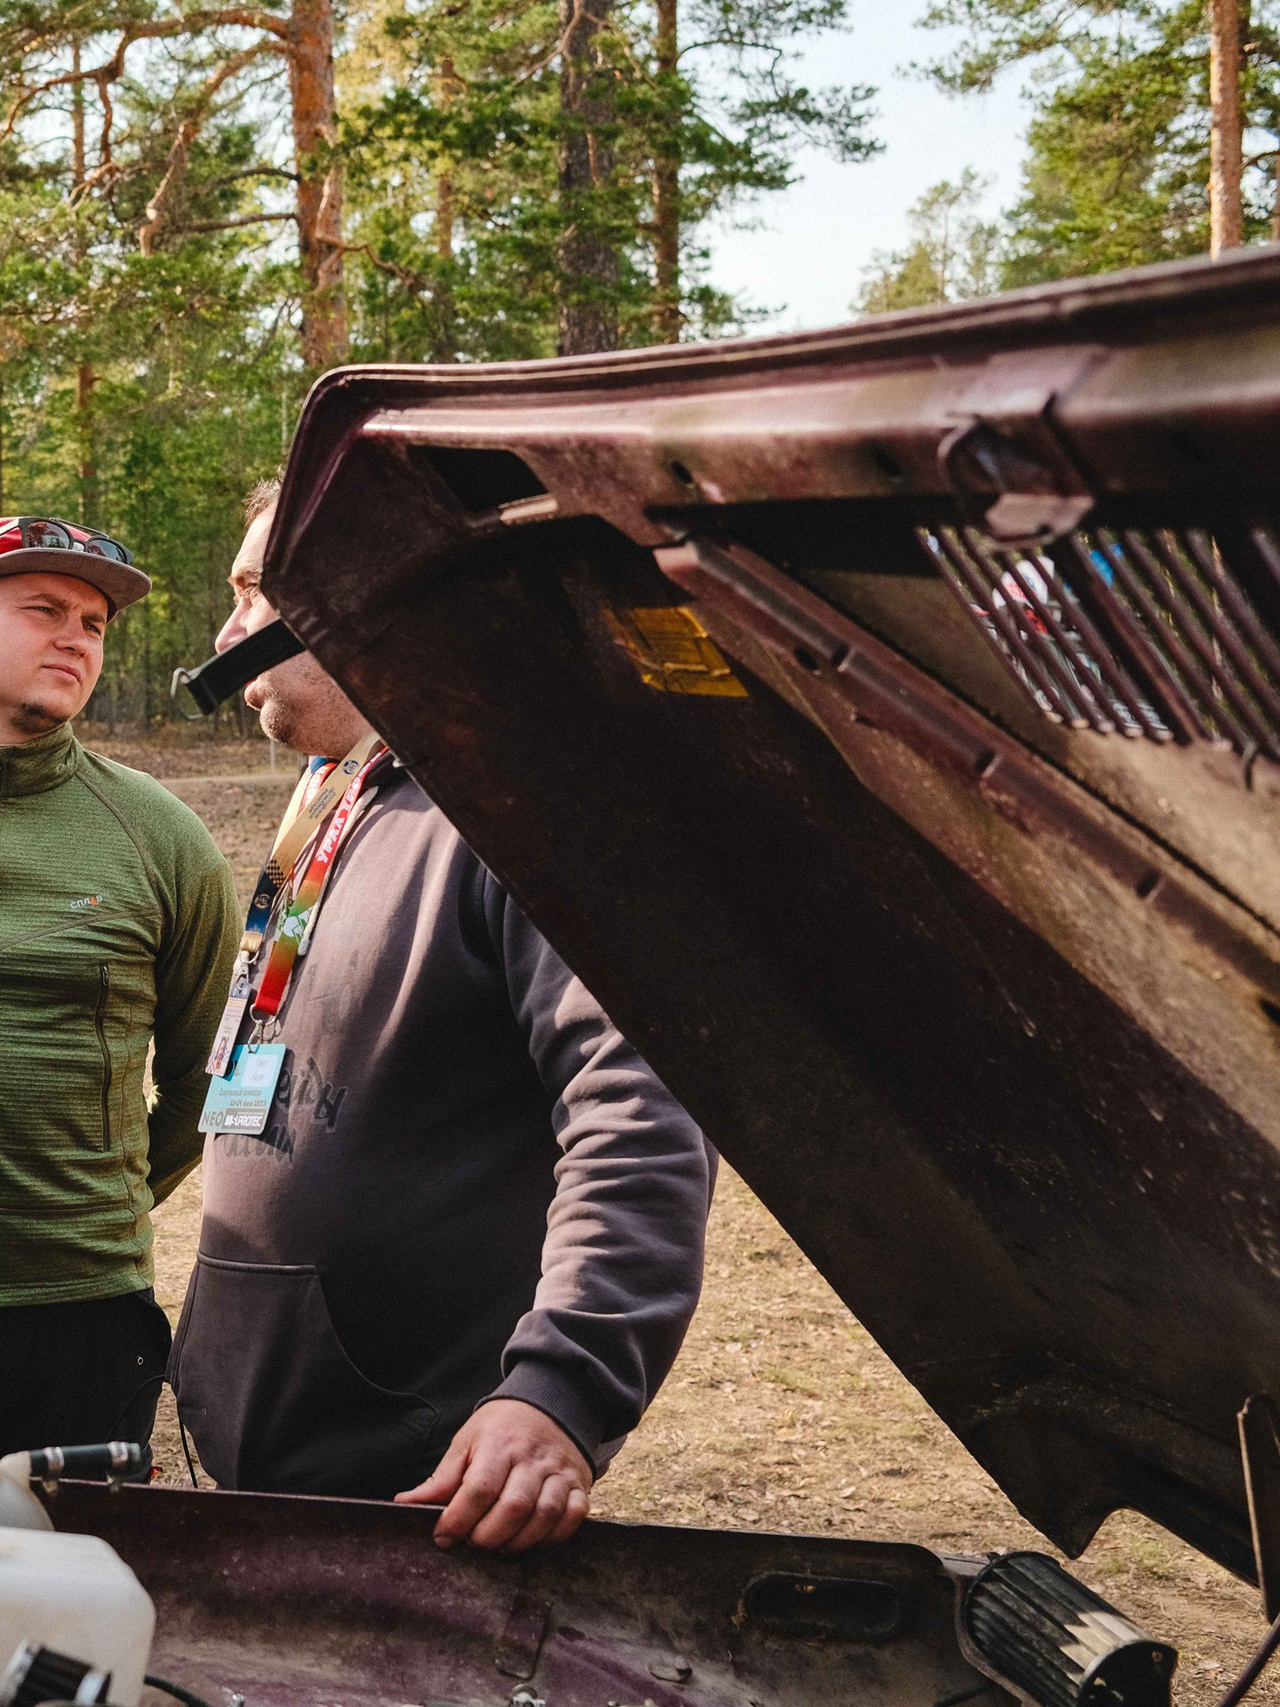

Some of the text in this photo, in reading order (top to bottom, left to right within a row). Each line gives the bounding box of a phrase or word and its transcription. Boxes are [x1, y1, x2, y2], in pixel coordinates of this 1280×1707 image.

[316, 817, 345, 863] УРАЛ
[202, 1111, 263, 1127] NEO SUPROTEC
